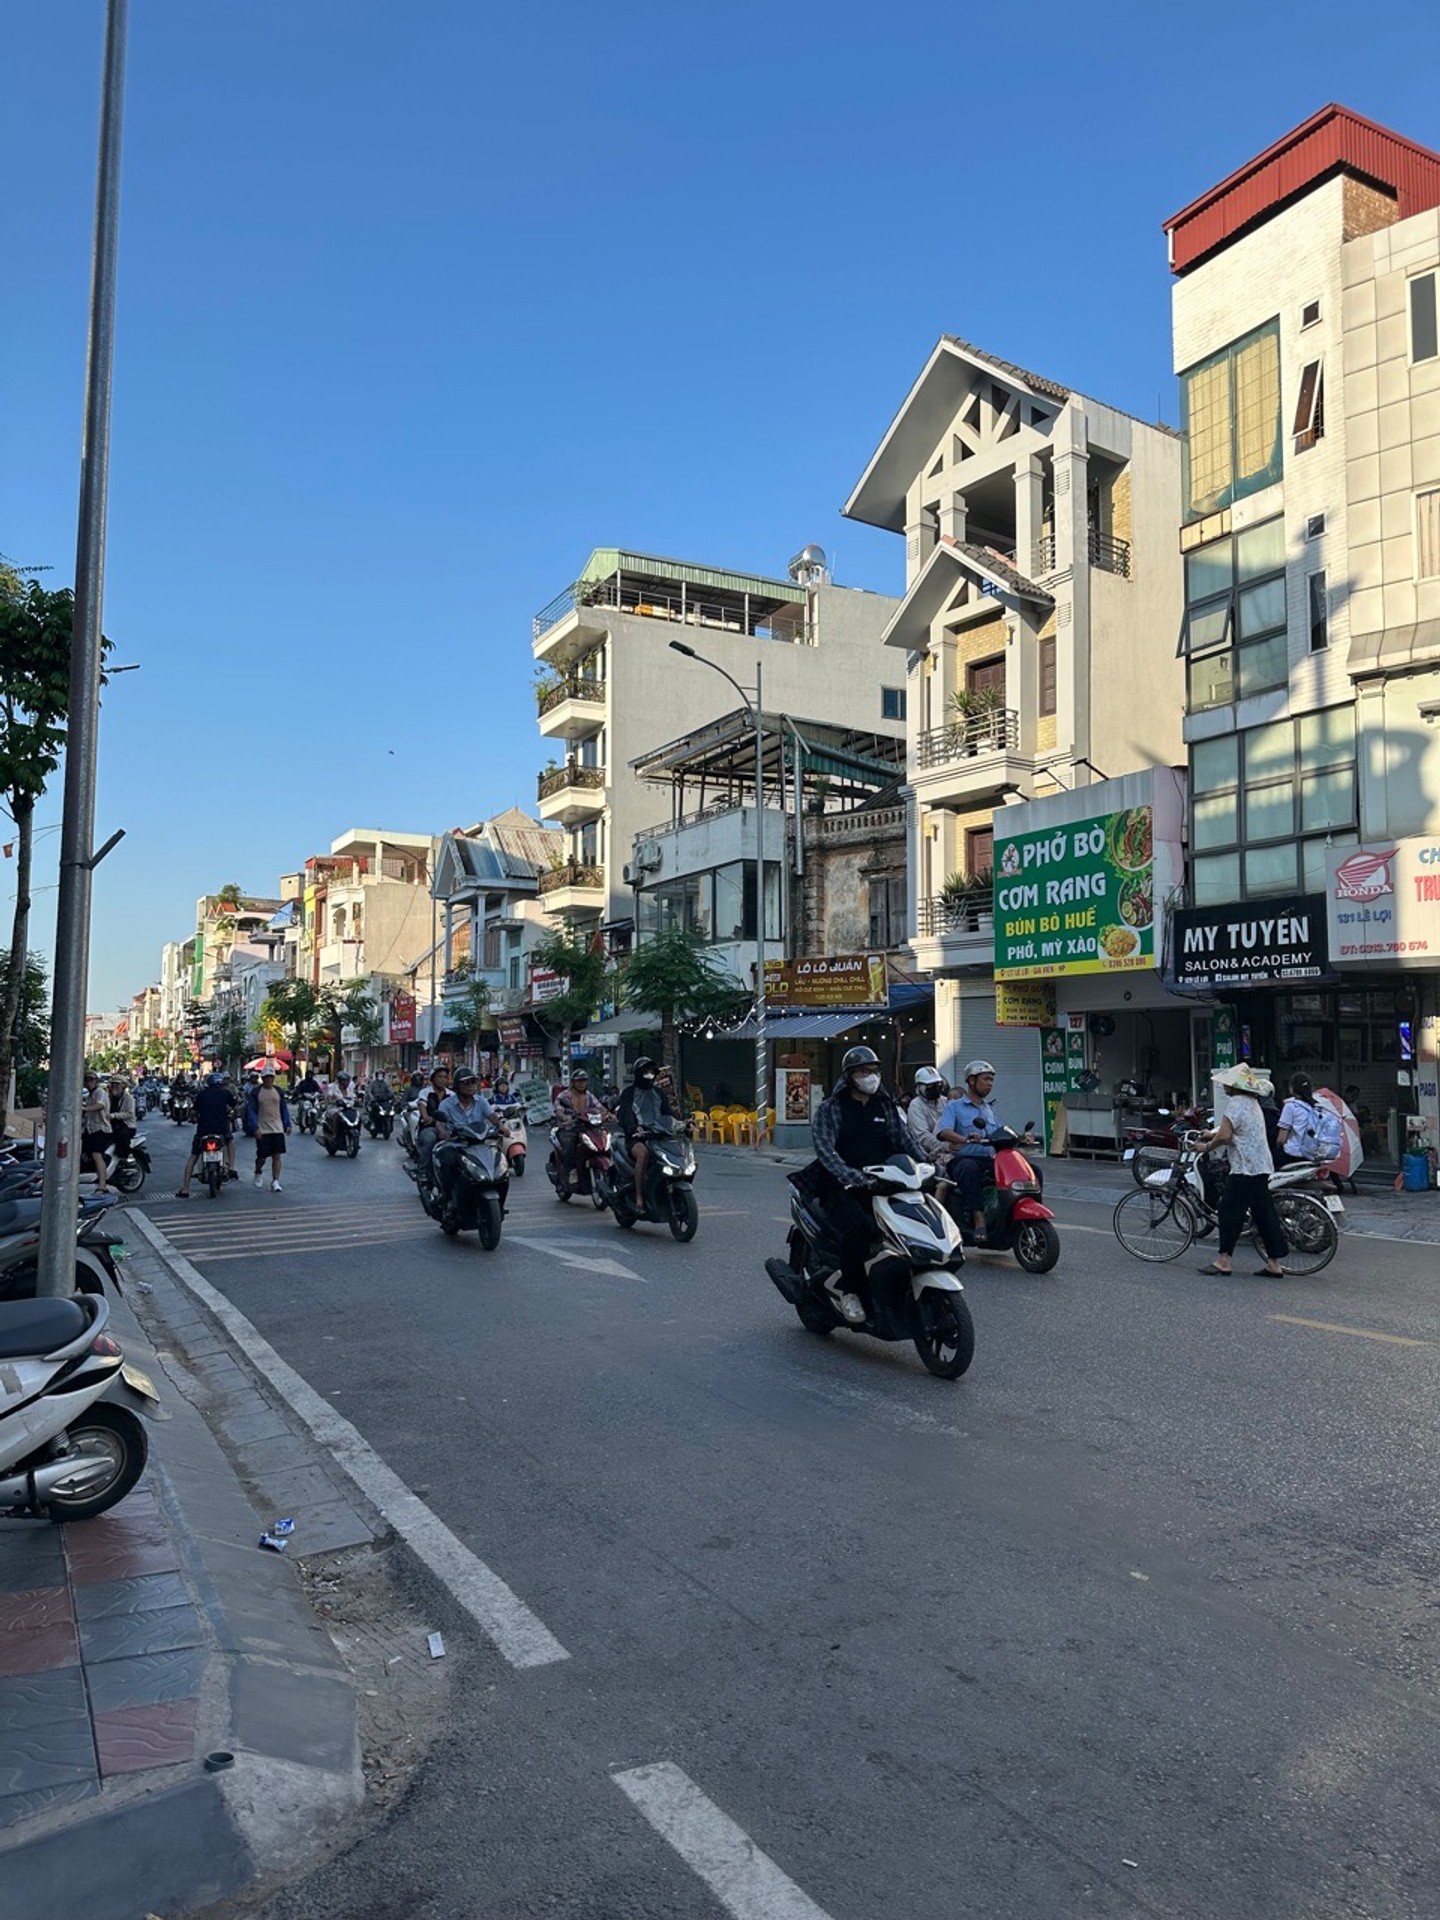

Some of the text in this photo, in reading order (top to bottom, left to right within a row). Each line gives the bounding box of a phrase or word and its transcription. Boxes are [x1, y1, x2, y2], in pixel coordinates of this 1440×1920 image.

[1023, 823, 1105, 868] PHỞ BÒ
[999, 872, 1106, 911] CƠM RANG
[1337, 885, 1392, 898] HONDA
[1005, 905, 1097, 937] BÚN BÒ HUẾ
[1357, 909, 1371, 922] LÊ
[1373, 909, 1392, 923] LỢI
[1041, 938, 1063, 957] MỲ
[1066, 936, 1096, 954] XÀO
[1070, 1017, 1082, 1028] 127
[1068, 1055, 1083, 1069] BÚN
[1044, 1081, 1068, 1094] RANG
